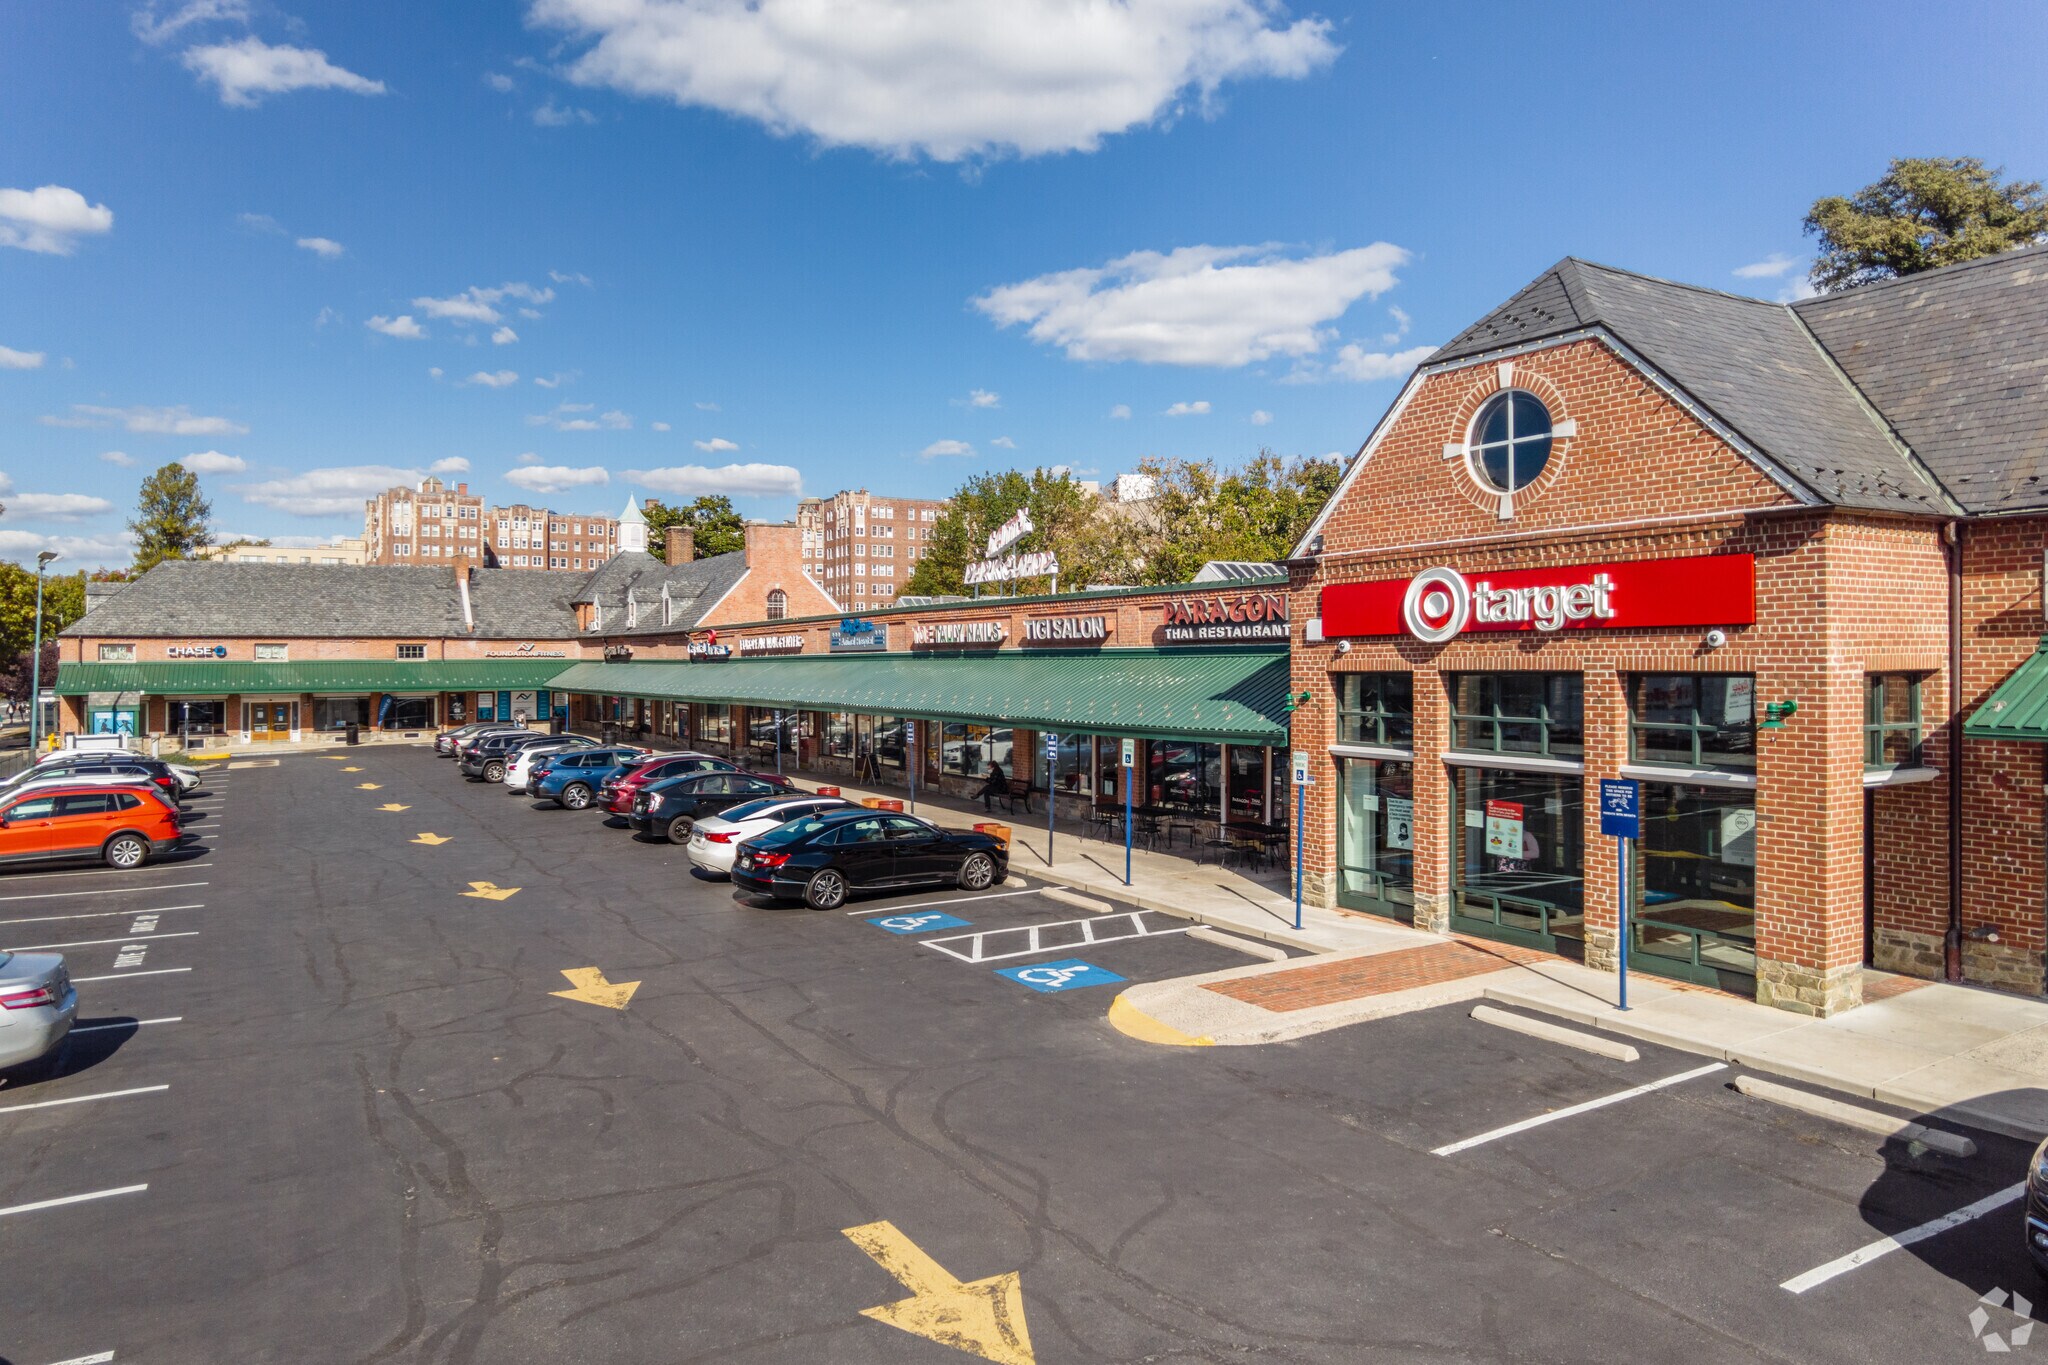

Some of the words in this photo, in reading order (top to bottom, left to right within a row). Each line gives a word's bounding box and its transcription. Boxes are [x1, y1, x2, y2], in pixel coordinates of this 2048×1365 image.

[1163, 593, 1289, 625] PARAGON
[1472, 573, 1615, 632] target
[966, 622, 1002, 642] NAILS
[1023, 618, 1050, 640] TIGI
[1052, 616, 1105, 639] SALON
[1165, 627, 1194, 640] THAI
[1199, 624, 1291, 639] RESTAURANT
[167, 646, 212, 656] CHASE
